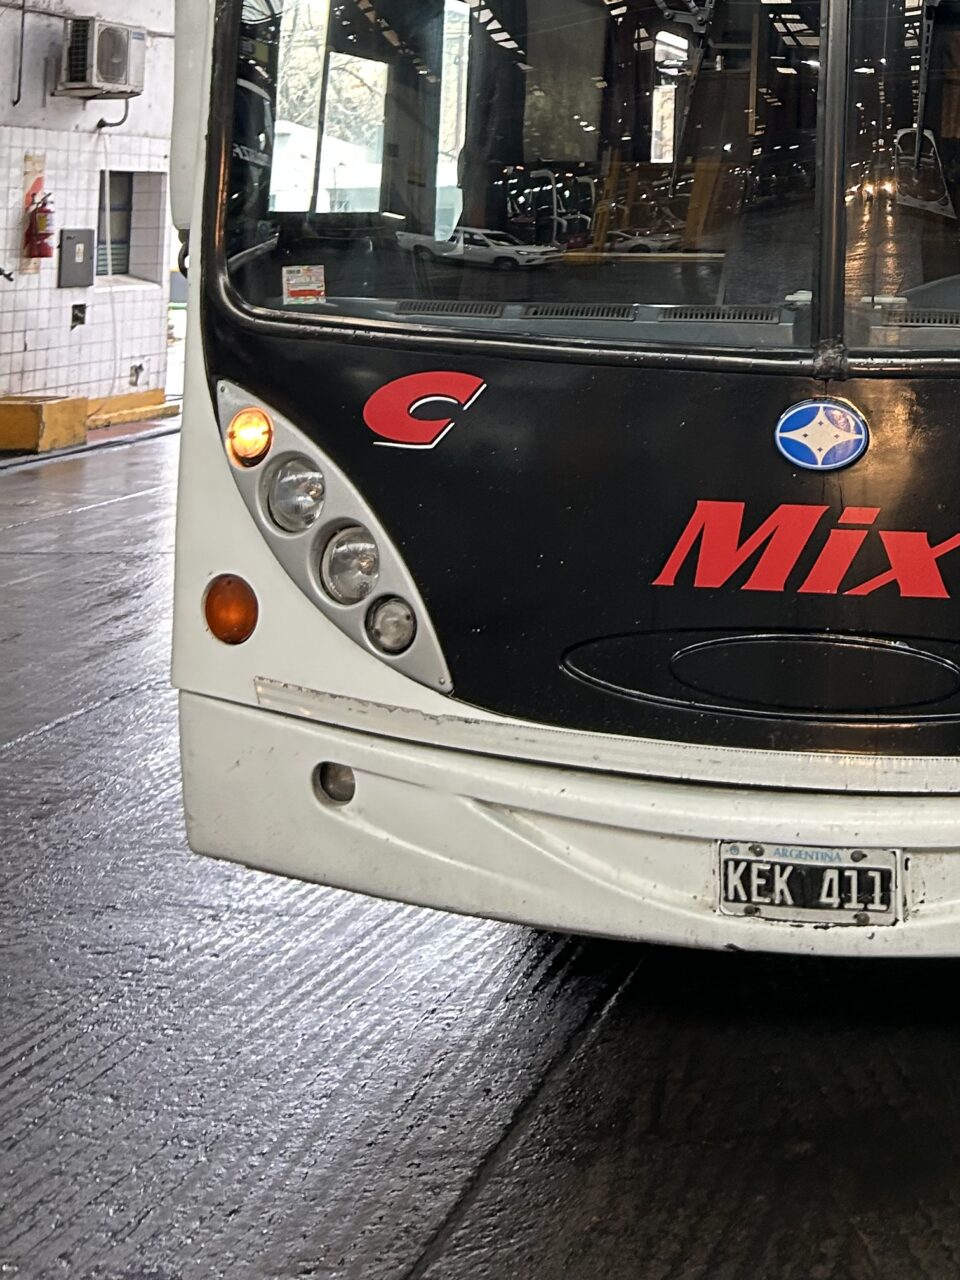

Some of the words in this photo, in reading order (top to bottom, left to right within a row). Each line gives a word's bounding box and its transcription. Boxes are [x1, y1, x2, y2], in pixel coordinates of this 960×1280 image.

[363, 371, 486, 449] C
[773, 847, 842, 862] ARGENTINA
[726, 860, 794, 905] KEK
[819, 868, 889, 911] 411
